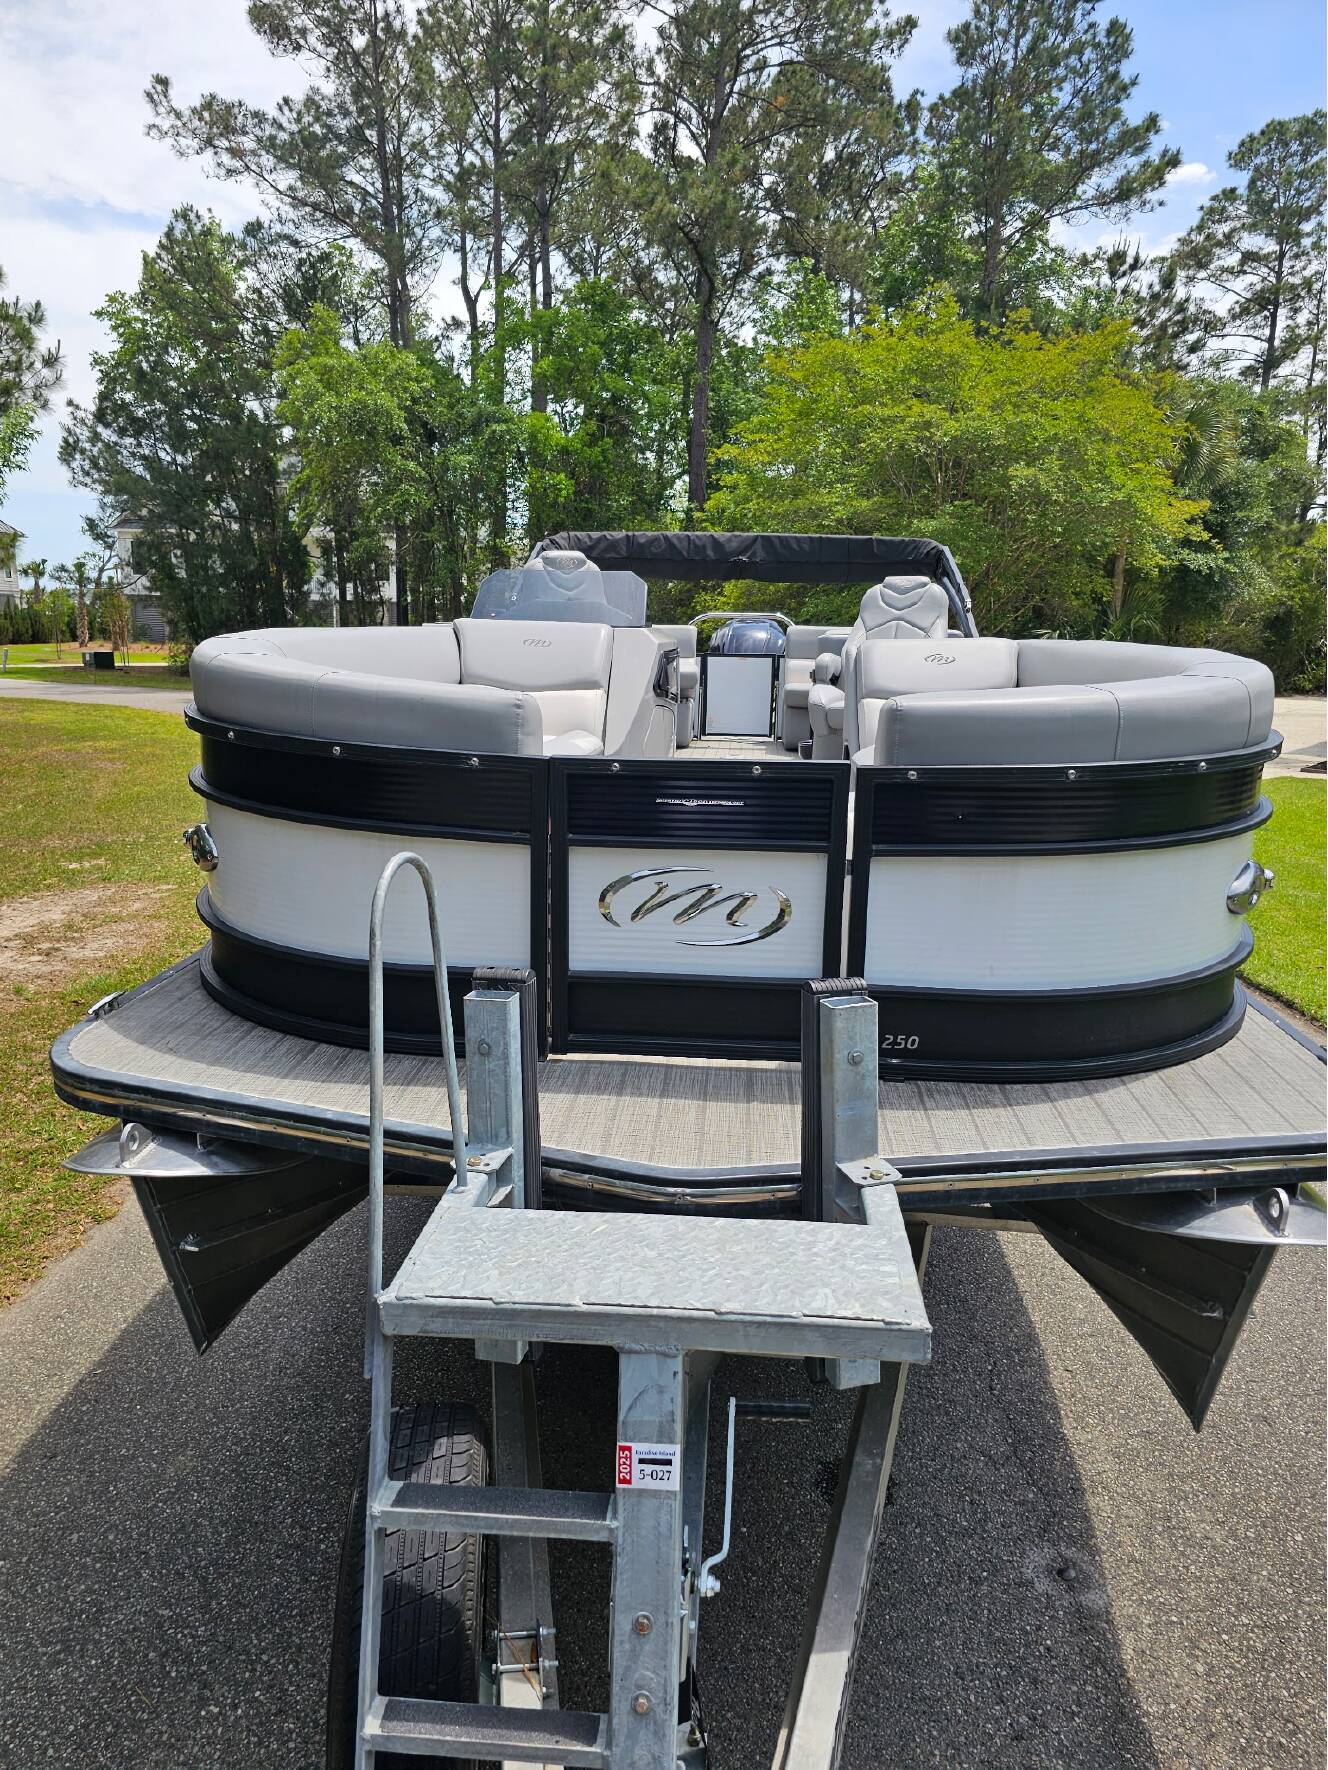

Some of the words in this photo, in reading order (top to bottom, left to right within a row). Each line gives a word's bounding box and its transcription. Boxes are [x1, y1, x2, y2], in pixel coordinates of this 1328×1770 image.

[881, 1034, 920, 1049] 250
[619, 1450, 631, 1480] 2025
[638, 1469, 672, 1481] 5-027
